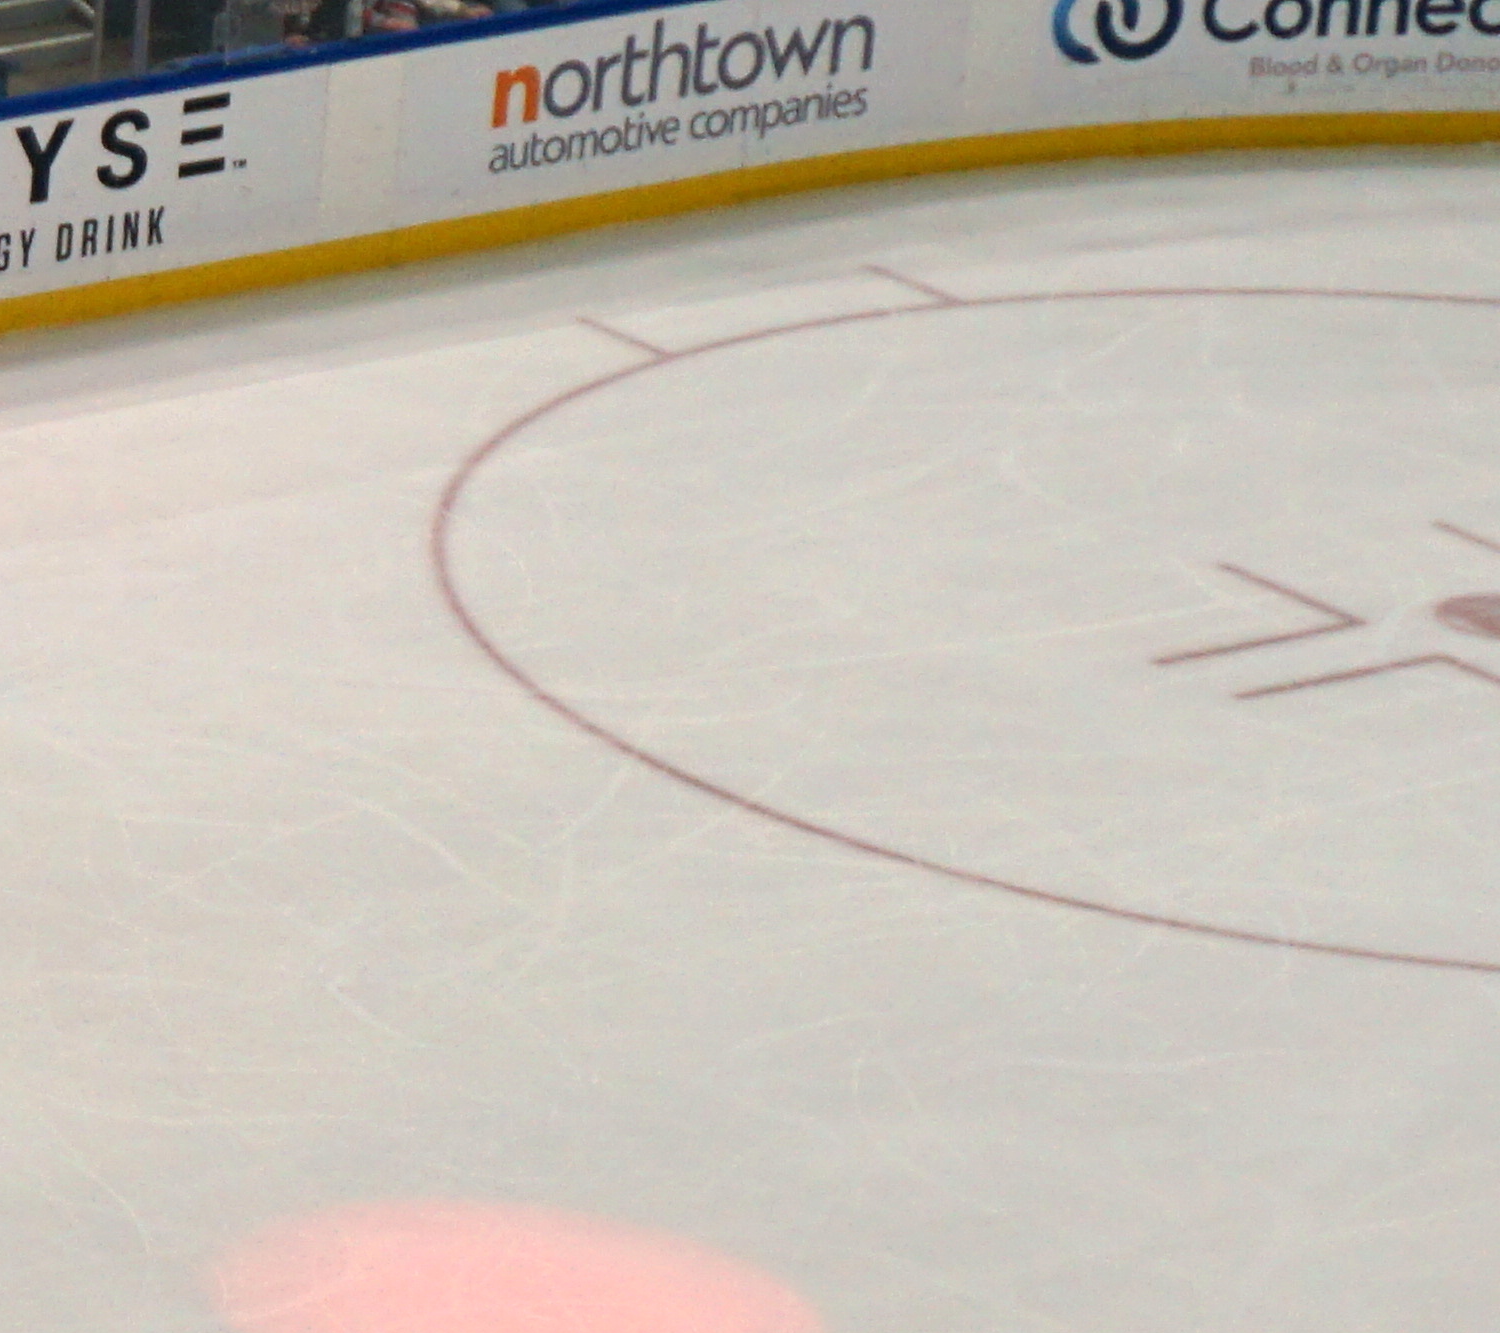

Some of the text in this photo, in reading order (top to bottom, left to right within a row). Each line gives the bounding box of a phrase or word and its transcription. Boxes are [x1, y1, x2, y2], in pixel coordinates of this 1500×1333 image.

[491, 14, 875, 128] northtown
[1248, 54, 1317, 79] Blood
[1352, 49, 1428, 79] Organ
[488, 82, 869, 174] automotive companies
[56, 205, 166, 262] DRINK
